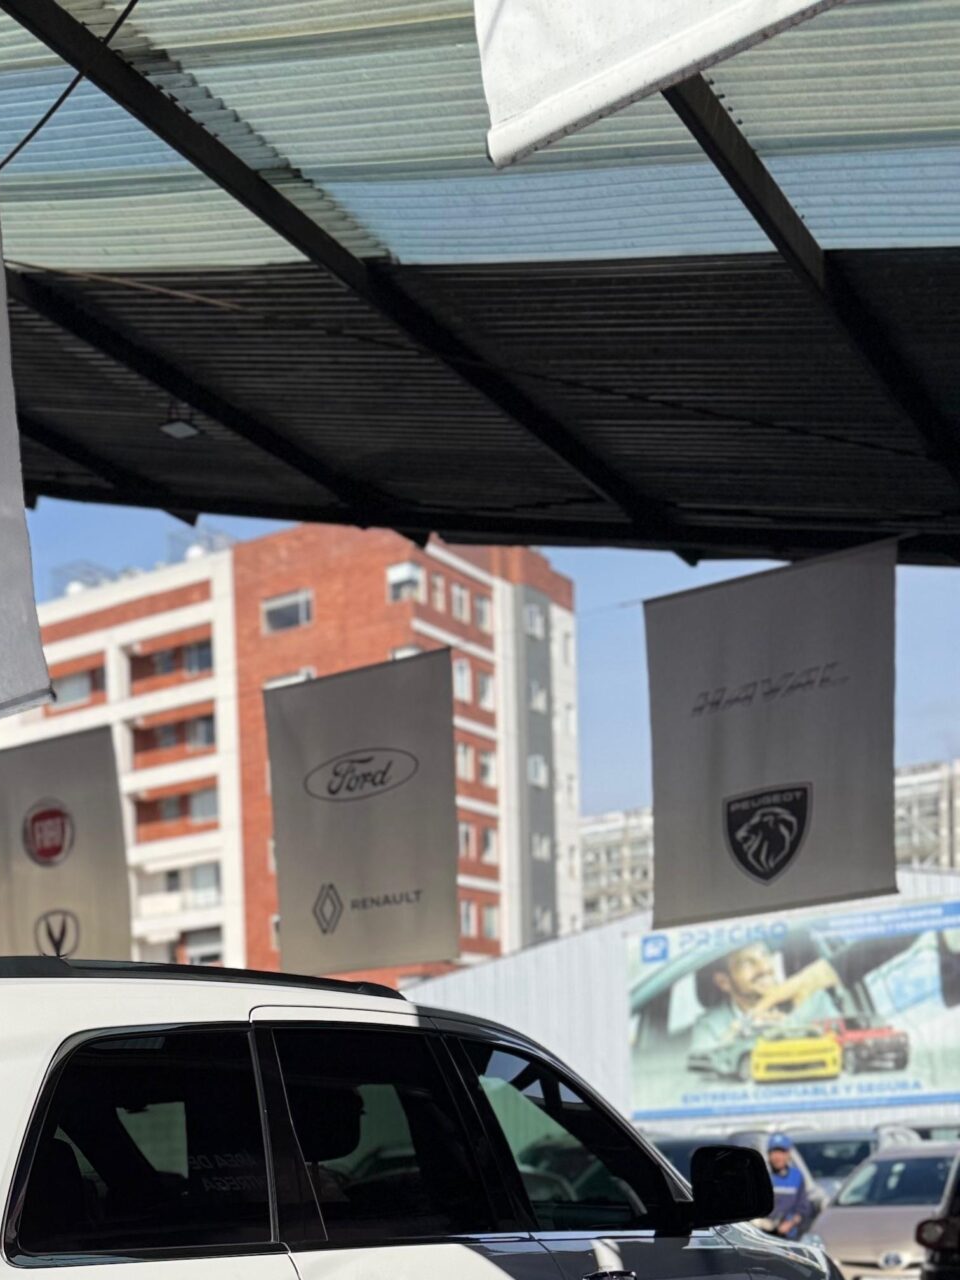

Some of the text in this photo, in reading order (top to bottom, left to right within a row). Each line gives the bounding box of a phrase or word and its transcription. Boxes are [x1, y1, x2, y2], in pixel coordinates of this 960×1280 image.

[327, 755, 393, 795] Ford
[730, 790, 804, 813] PEUGEOT
[351, 889, 423, 912] RENAULT
